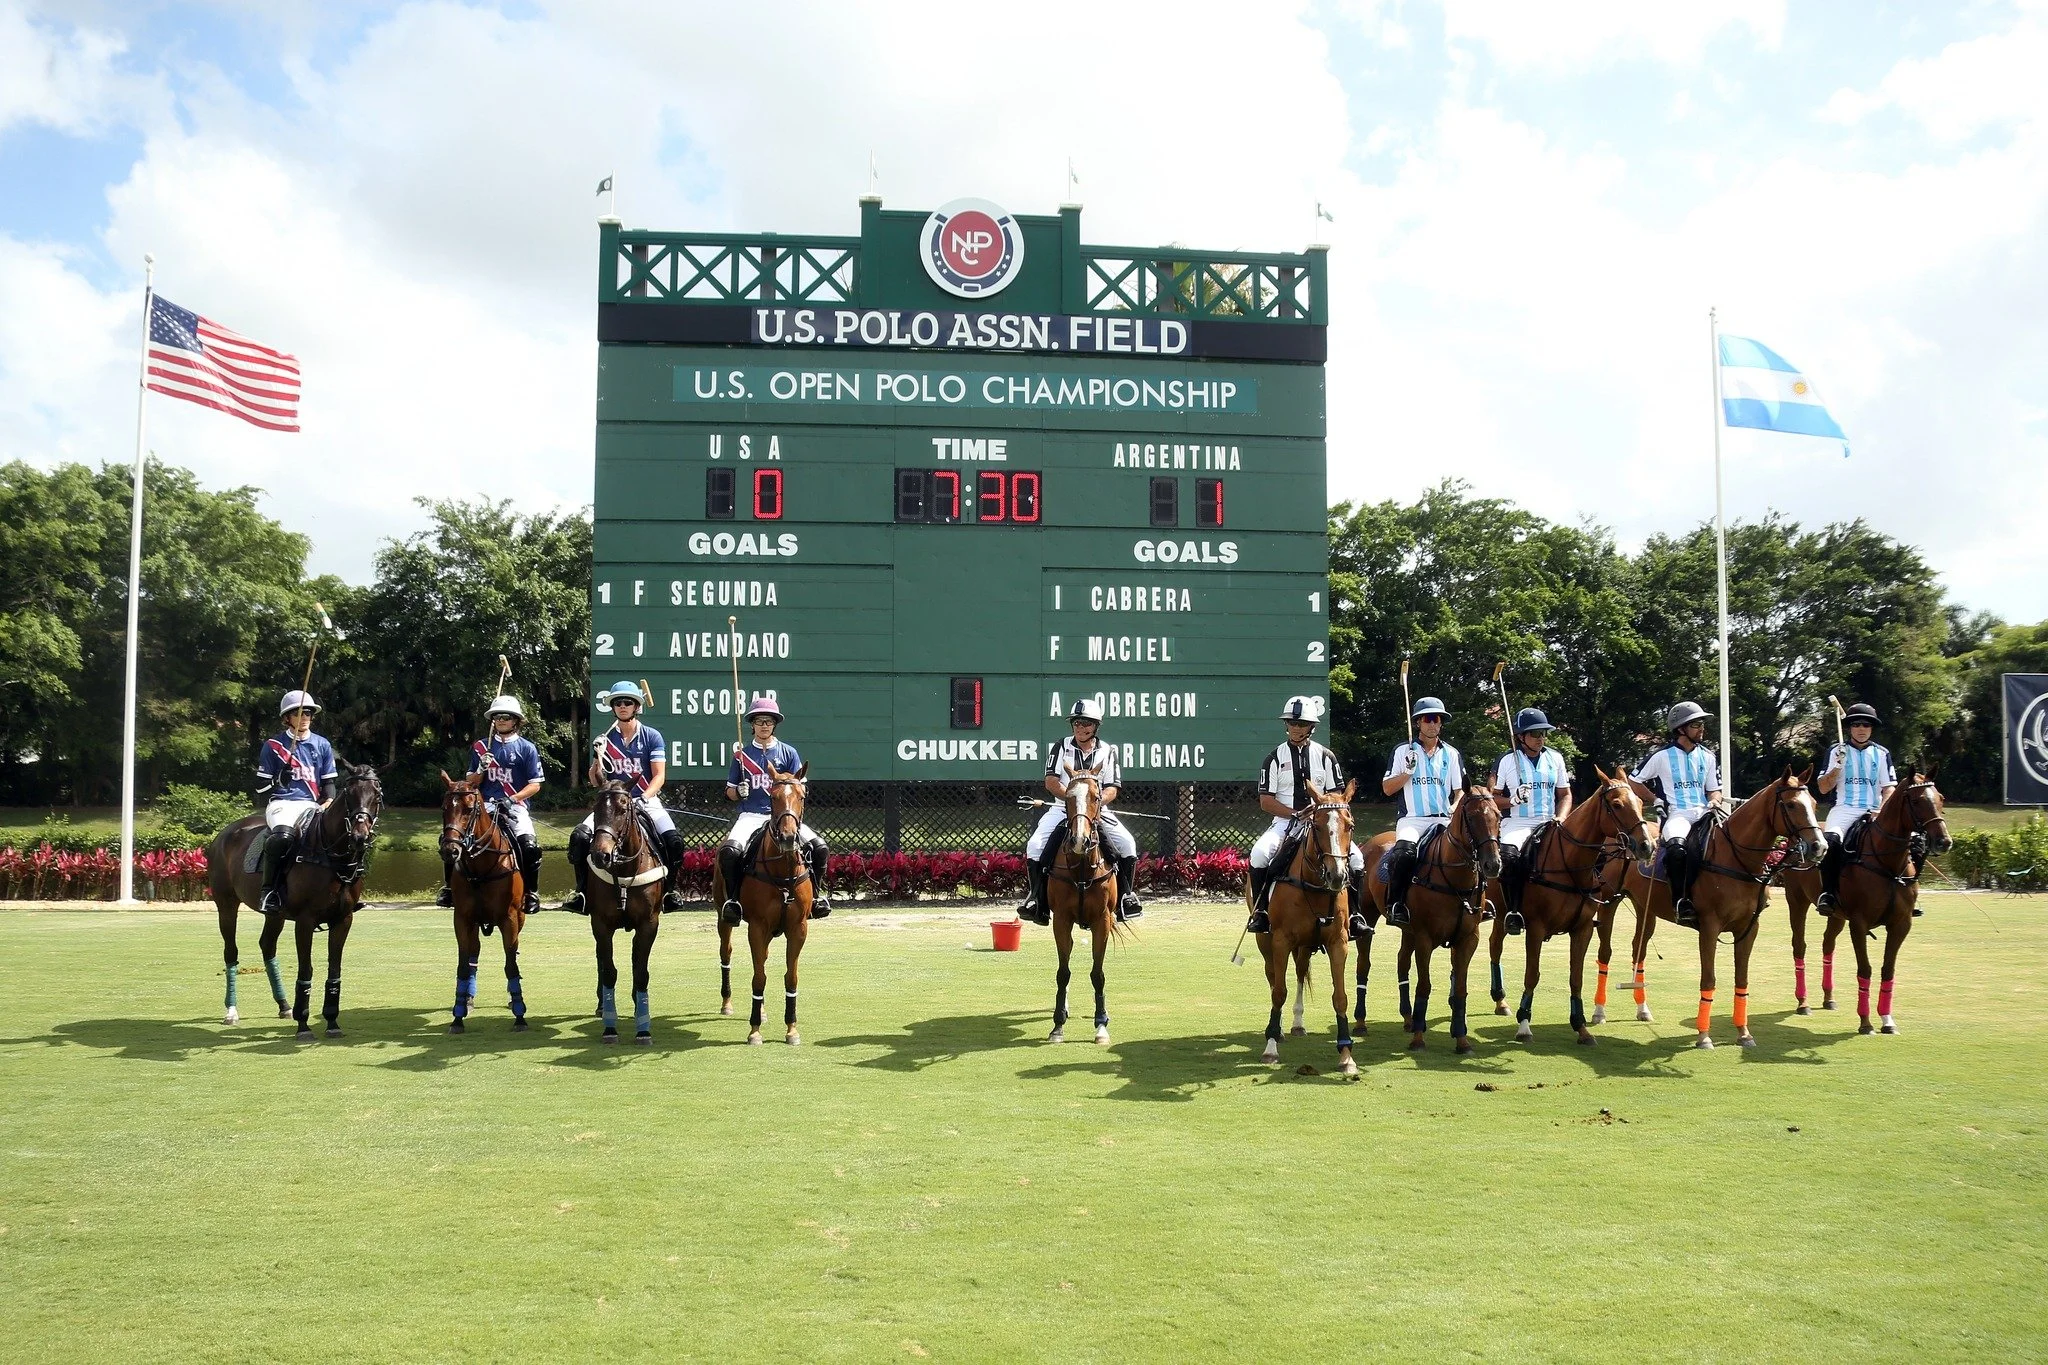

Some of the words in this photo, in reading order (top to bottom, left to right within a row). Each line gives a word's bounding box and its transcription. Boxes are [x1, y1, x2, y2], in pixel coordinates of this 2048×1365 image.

[756, 309, 825, 344] U.S.
[834, 310, 940, 346] POLO
[946, 313, 1059, 351] ASSN.
[1069, 316, 1188, 354] FIELD
[694, 370, 754, 399] U.S.
[769, 371, 861, 401] OPEN
[876, 373, 967, 403] POLO
[982, 375, 1237, 409] CHAMPIONSHIP
[931, 437, 1007, 461] TIME
[1113, 442, 1242, 471] ARGENTINA
[753, 468, 783, 519] 0
[934, 471, 1039, 521] 7:30
[1215, 480, 1224, 526] 1
[688, 532, 799, 557] GOALS
[1133, 539, 1239, 564] GOALS
[597, 582, 611, 604] 1
[634, 580, 645, 606] F
[670, 580, 778, 607] SEGUNDA
[1091, 585, 1192, 612] CABRERA
[1308, 591, 1320, 613] 1
[595, 633, 615, 656] 2
[632, 631, 644, 657] J
[1050, 635, 1060, 661] F
[1088, 635, 1172, 662] MACIEL
[1307, 641, 1325, 662] 2
[1050, 691, 1062, 717] A
[1094, 691, 1197, 718] OBREGON
[897, 739, 1038, 761] CHUKKER
[488, 767, 513, 783] USA
[611, 757, 644, 774] USA
[751, 773, 774, 790] US
